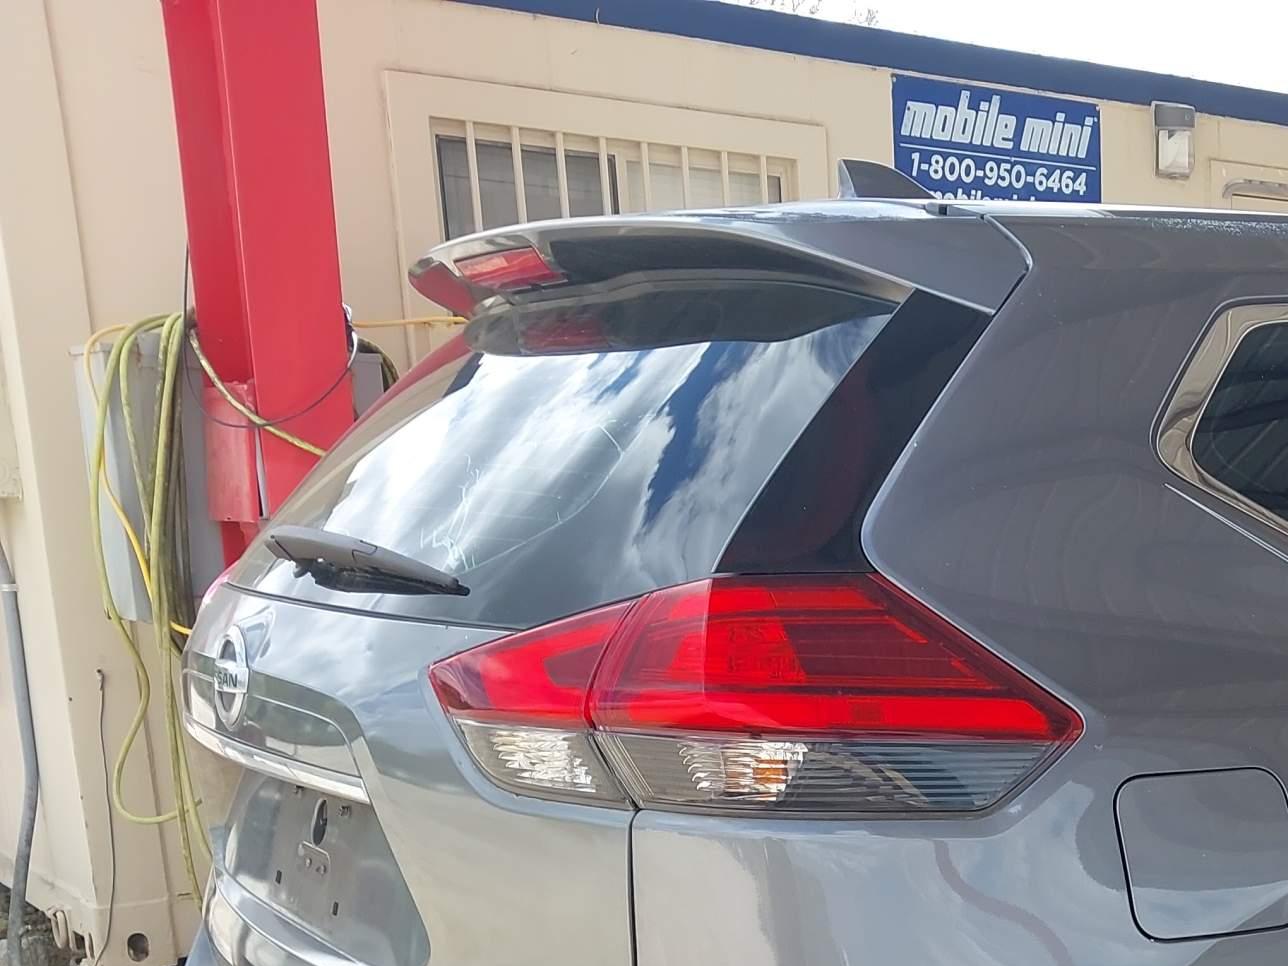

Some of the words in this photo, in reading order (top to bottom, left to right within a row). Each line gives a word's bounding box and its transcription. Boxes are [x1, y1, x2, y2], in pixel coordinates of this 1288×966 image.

[901, 90, 1017, 149] mobile
[1020, 112, 1093, 159] mini
[911, 152, 1087, 196] 1-800-950-6464
